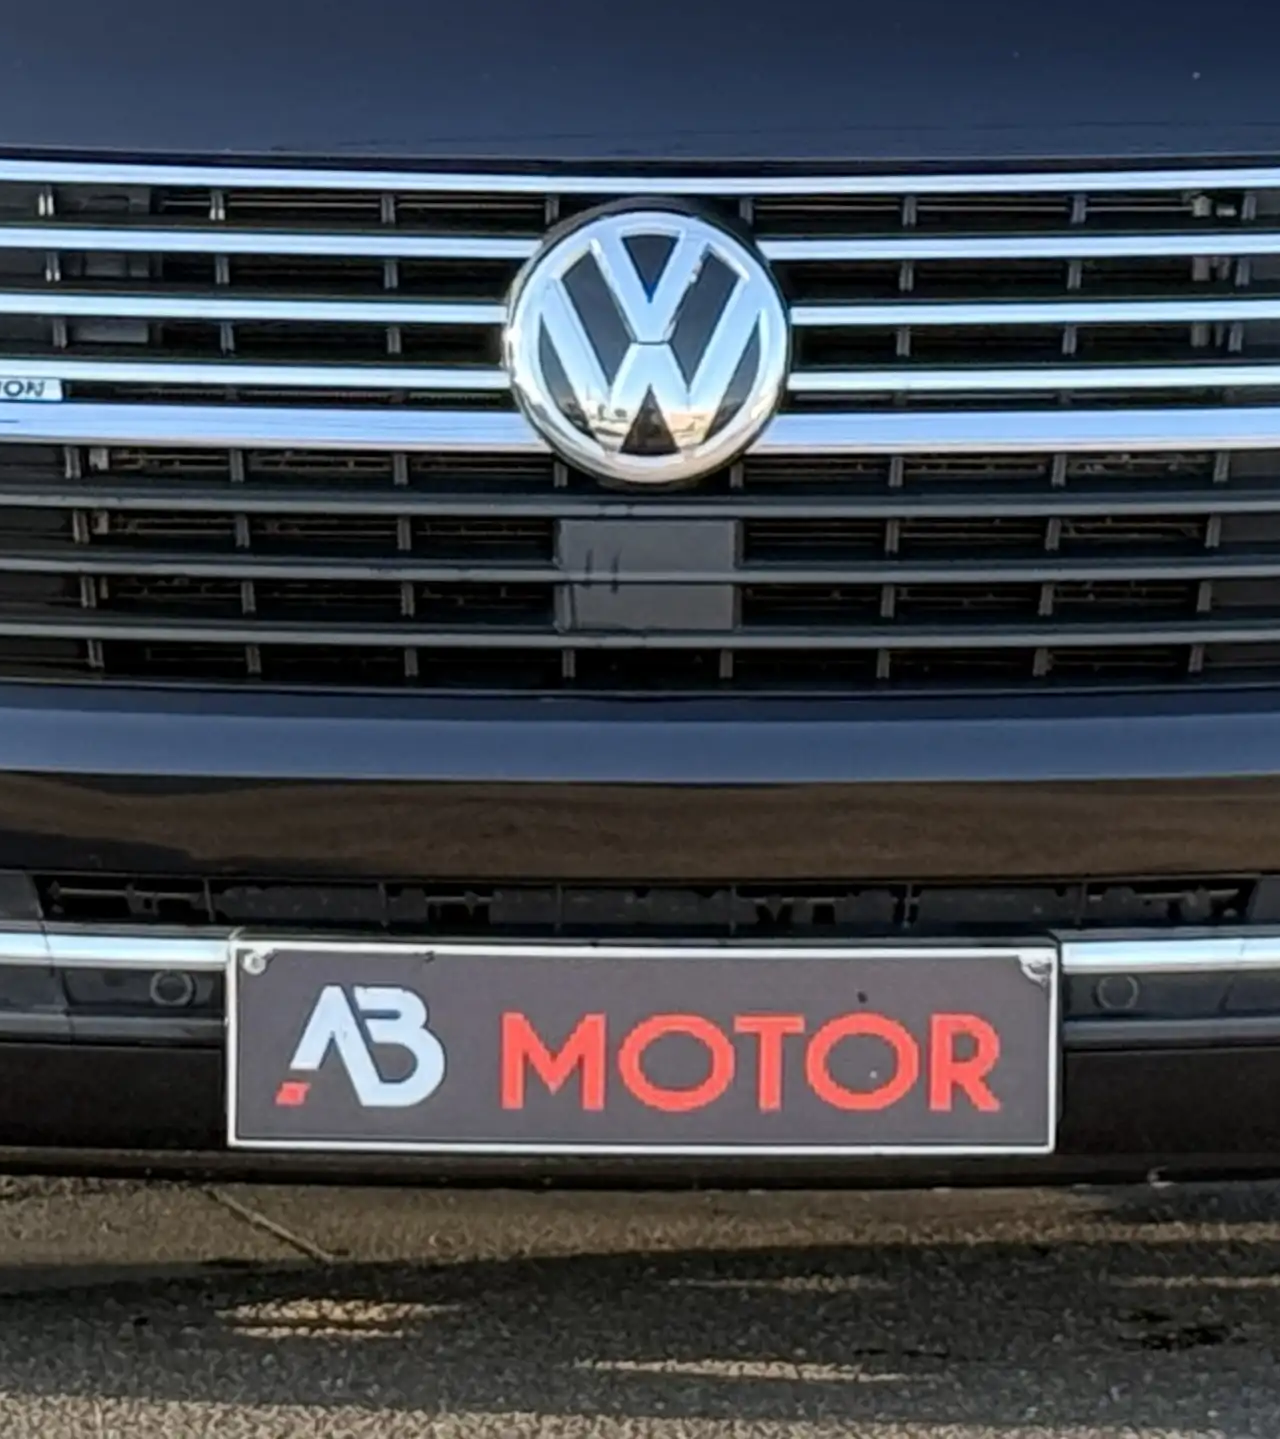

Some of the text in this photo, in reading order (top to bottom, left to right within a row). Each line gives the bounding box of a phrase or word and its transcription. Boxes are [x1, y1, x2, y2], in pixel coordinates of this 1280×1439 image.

[526, 220, 776, 465] VW
[278, 985, 1001, 1112] AB MOTOR
